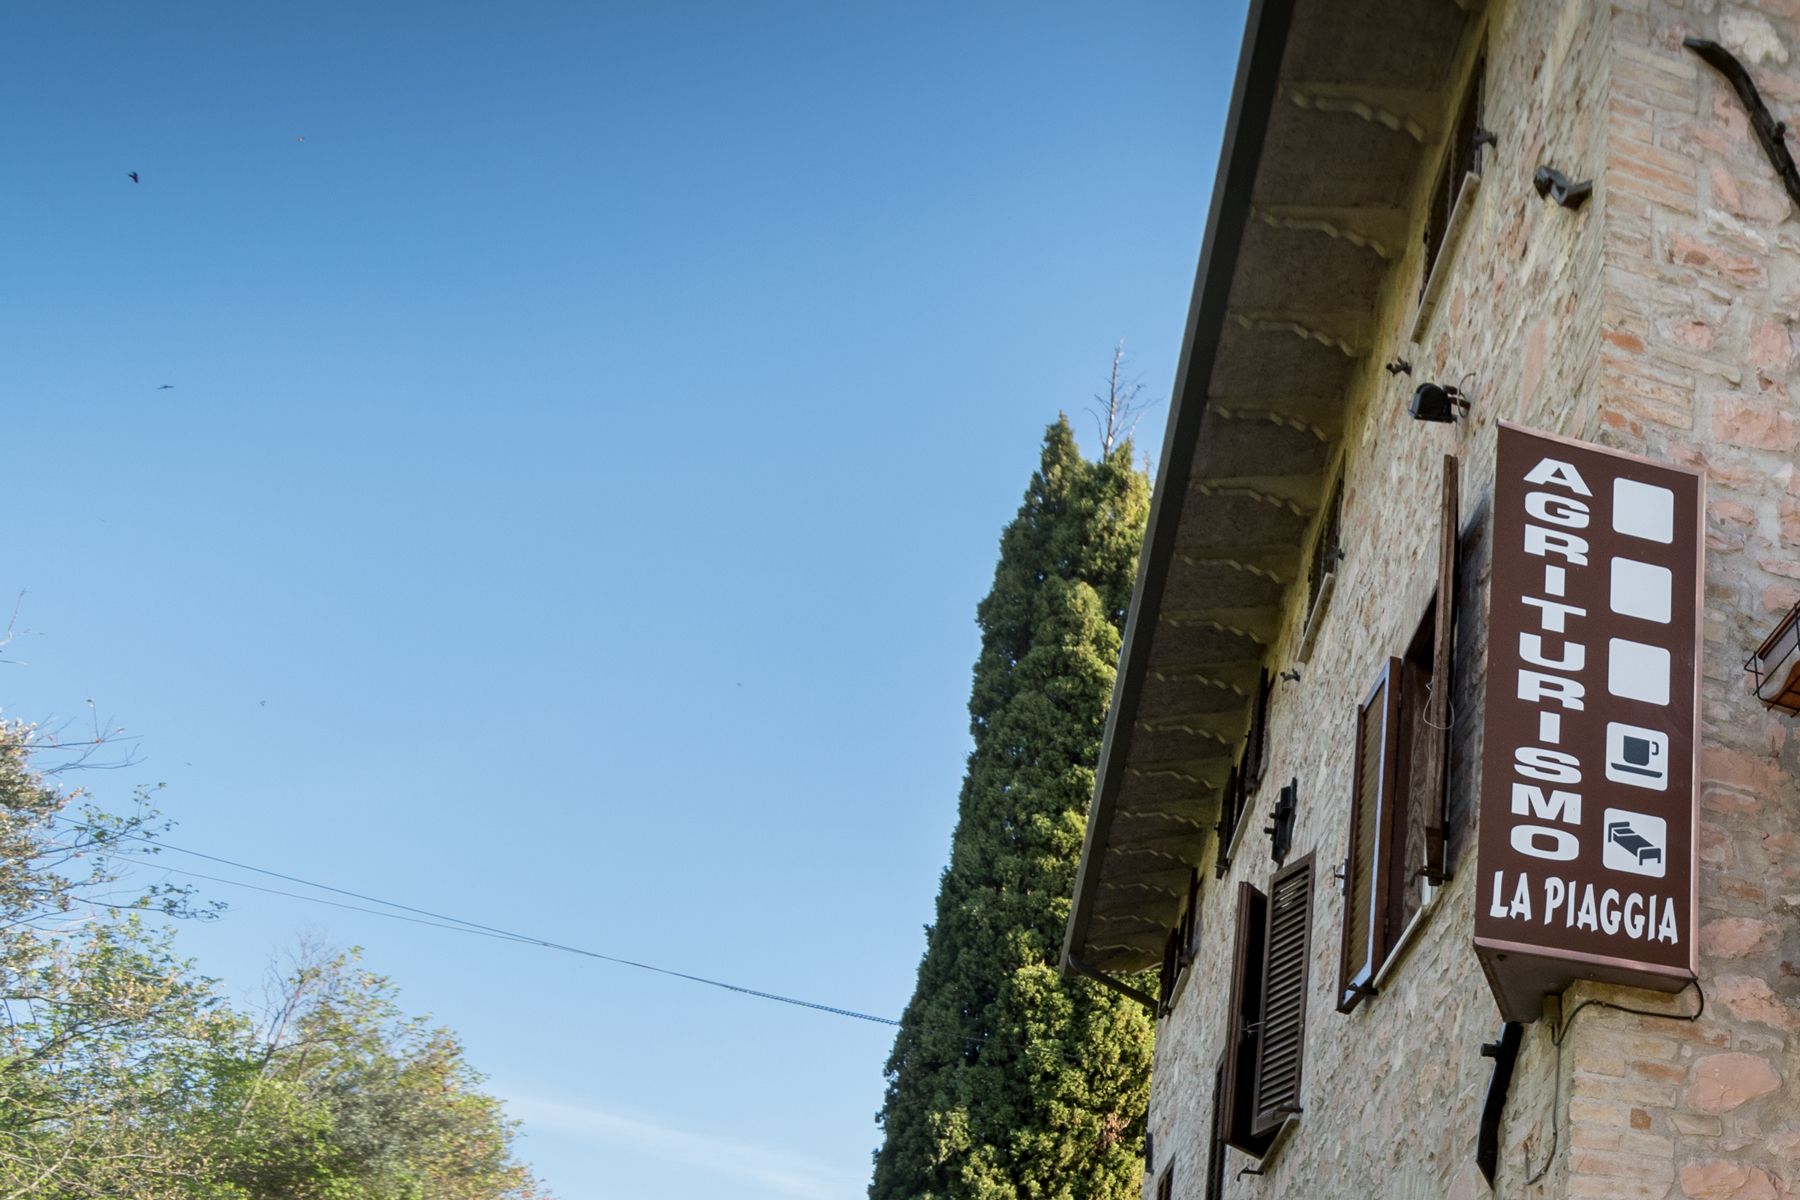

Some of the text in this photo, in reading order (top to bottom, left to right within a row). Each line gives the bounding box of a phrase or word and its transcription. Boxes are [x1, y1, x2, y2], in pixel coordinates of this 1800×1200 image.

[1510, 457, 1593, 862] AGRITURISMO
[1489, 870, 1679, 945] LA PIAGGIA
